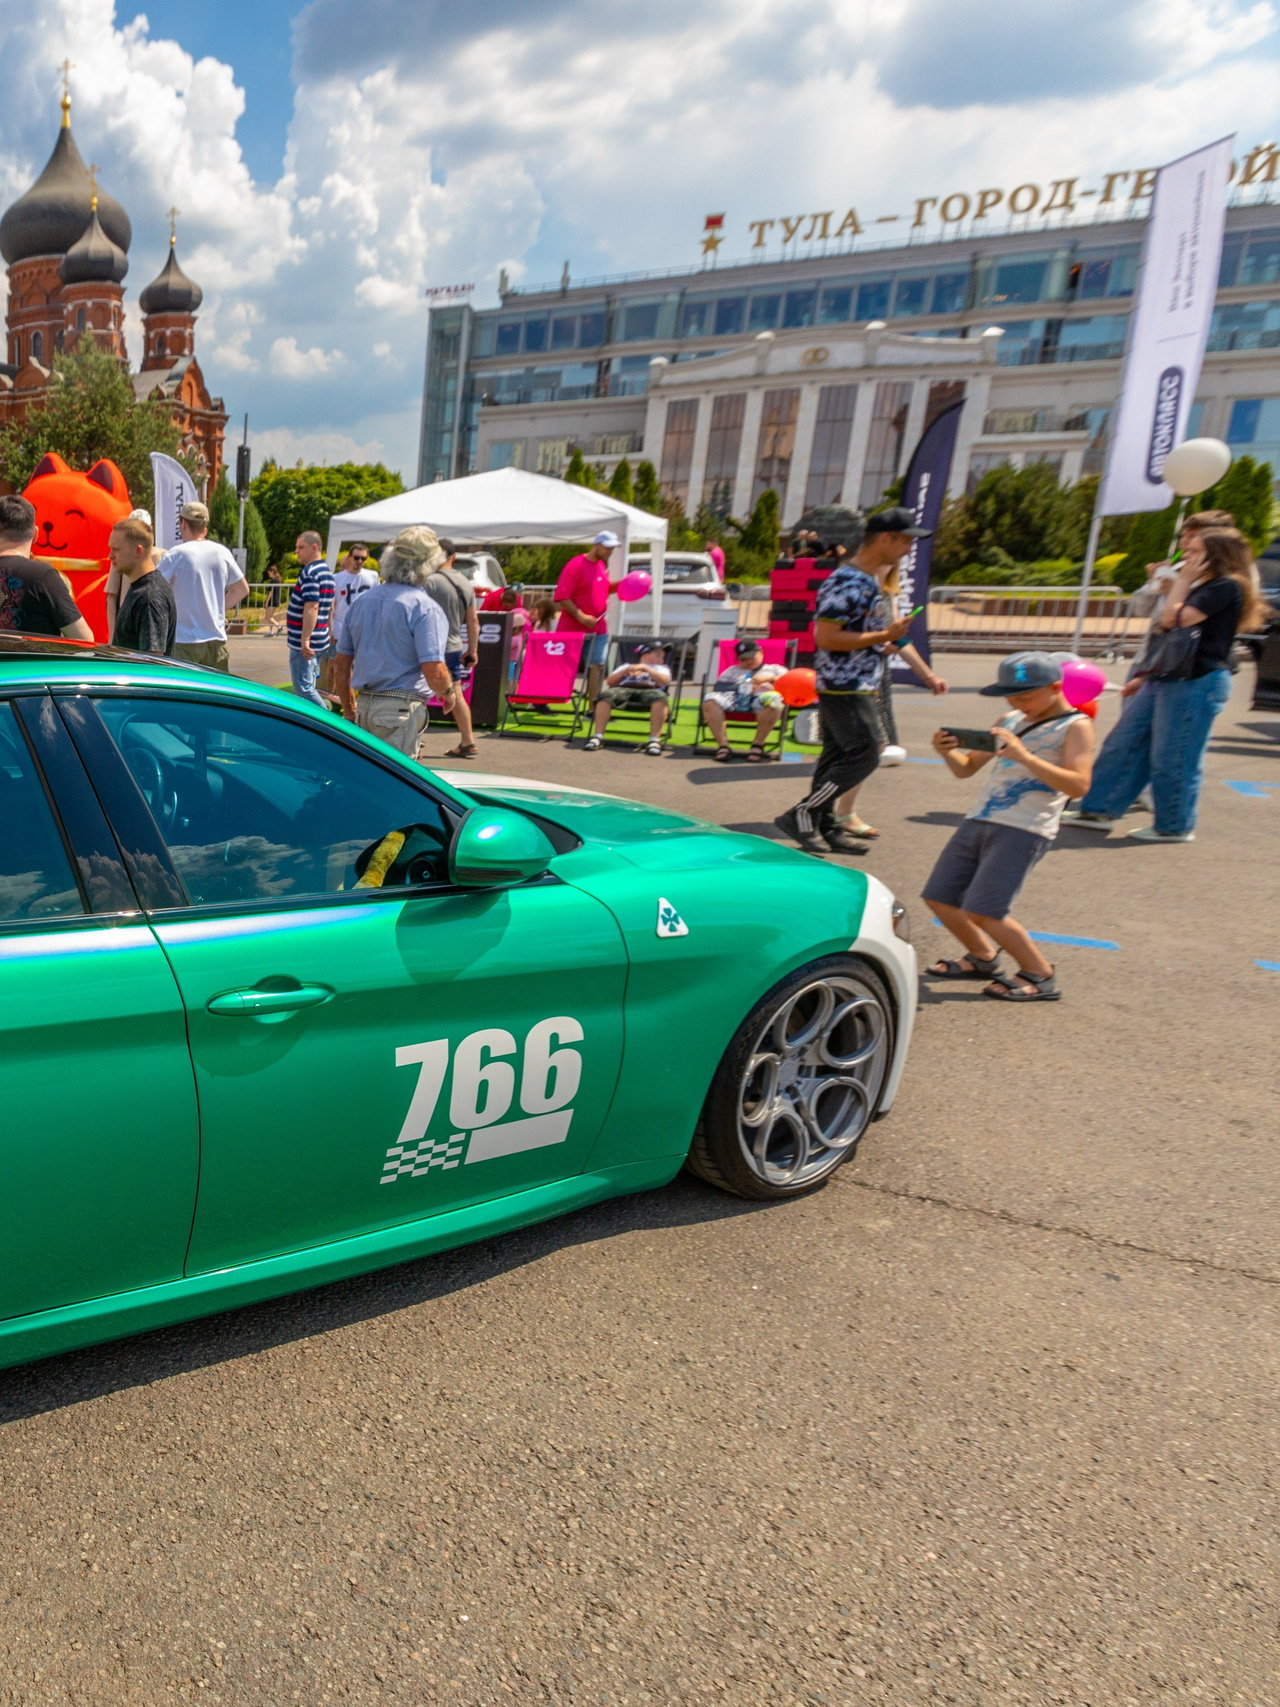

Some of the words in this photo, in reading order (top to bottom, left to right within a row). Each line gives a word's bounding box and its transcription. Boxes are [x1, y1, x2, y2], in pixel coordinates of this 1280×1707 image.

[749, 206, 863, 248] ТУЛА
[913, 141, 1280, 229] ГОРОД-ГЕЙ
[543, 640, 566, 656] t2
[395, 1016, 584, 1144] 766
